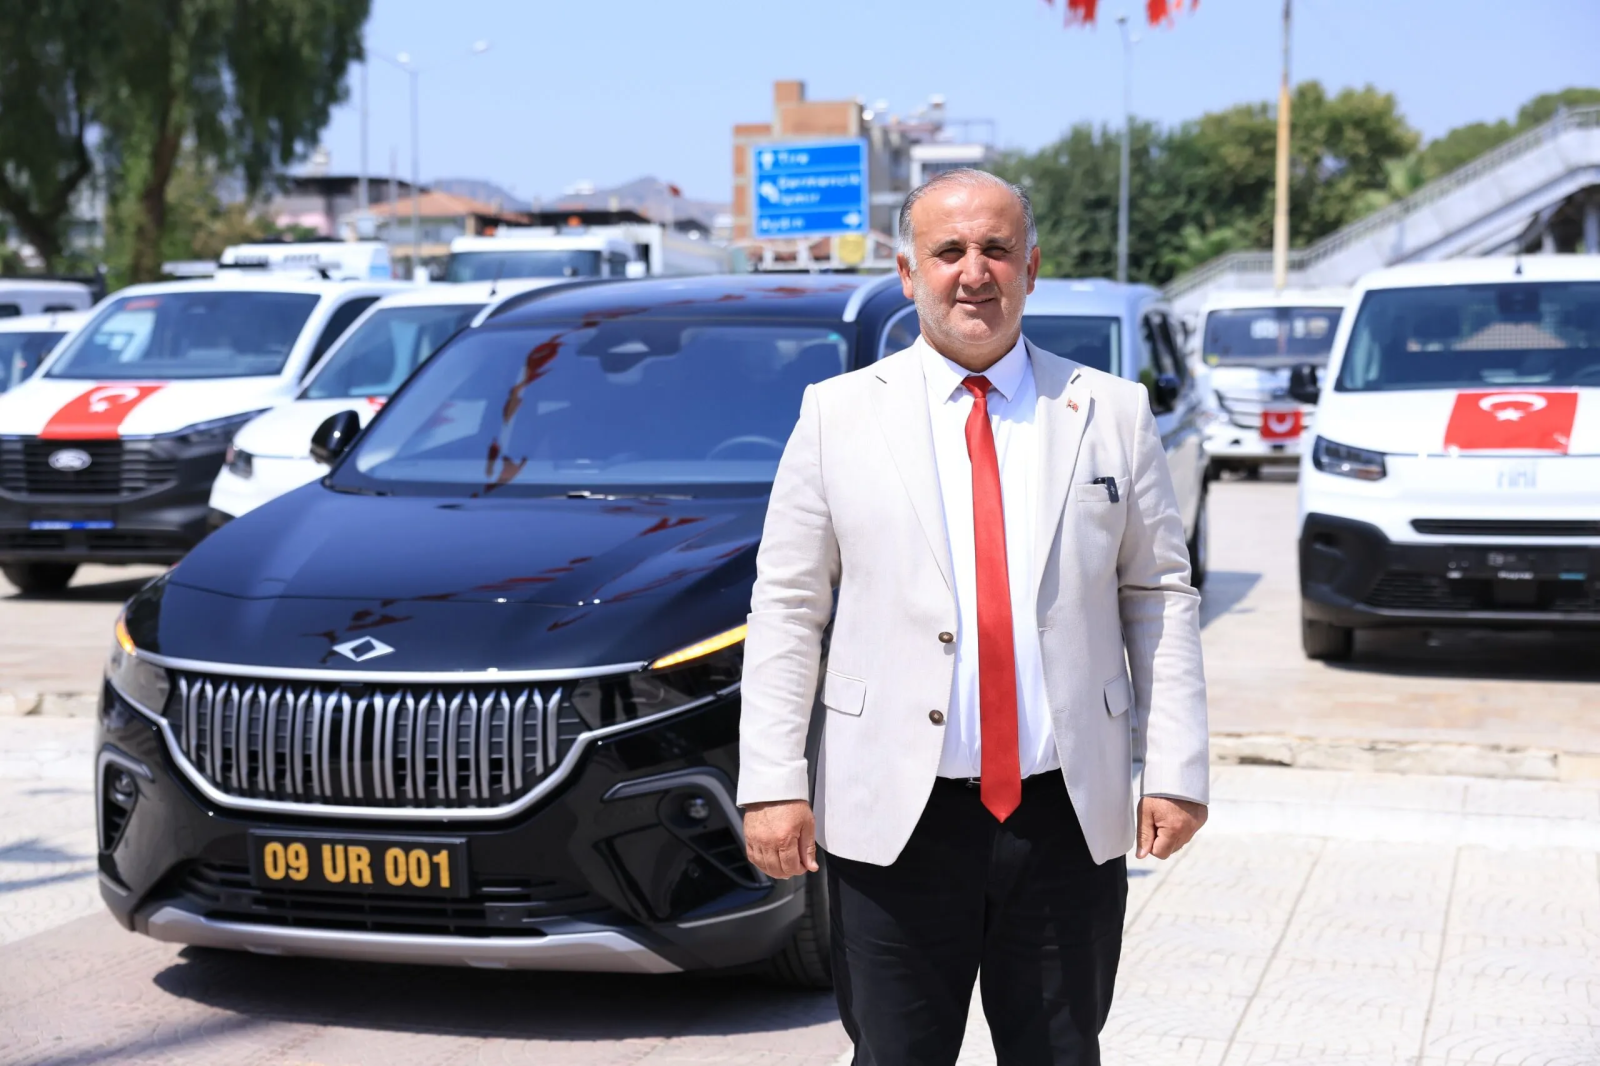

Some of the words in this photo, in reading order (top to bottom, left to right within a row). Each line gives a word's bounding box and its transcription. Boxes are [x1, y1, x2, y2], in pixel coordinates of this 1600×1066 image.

[263, 842, 309, 881] 09
[321, 844, 374, 884] UR
[384, 847, 450, 888] 001
